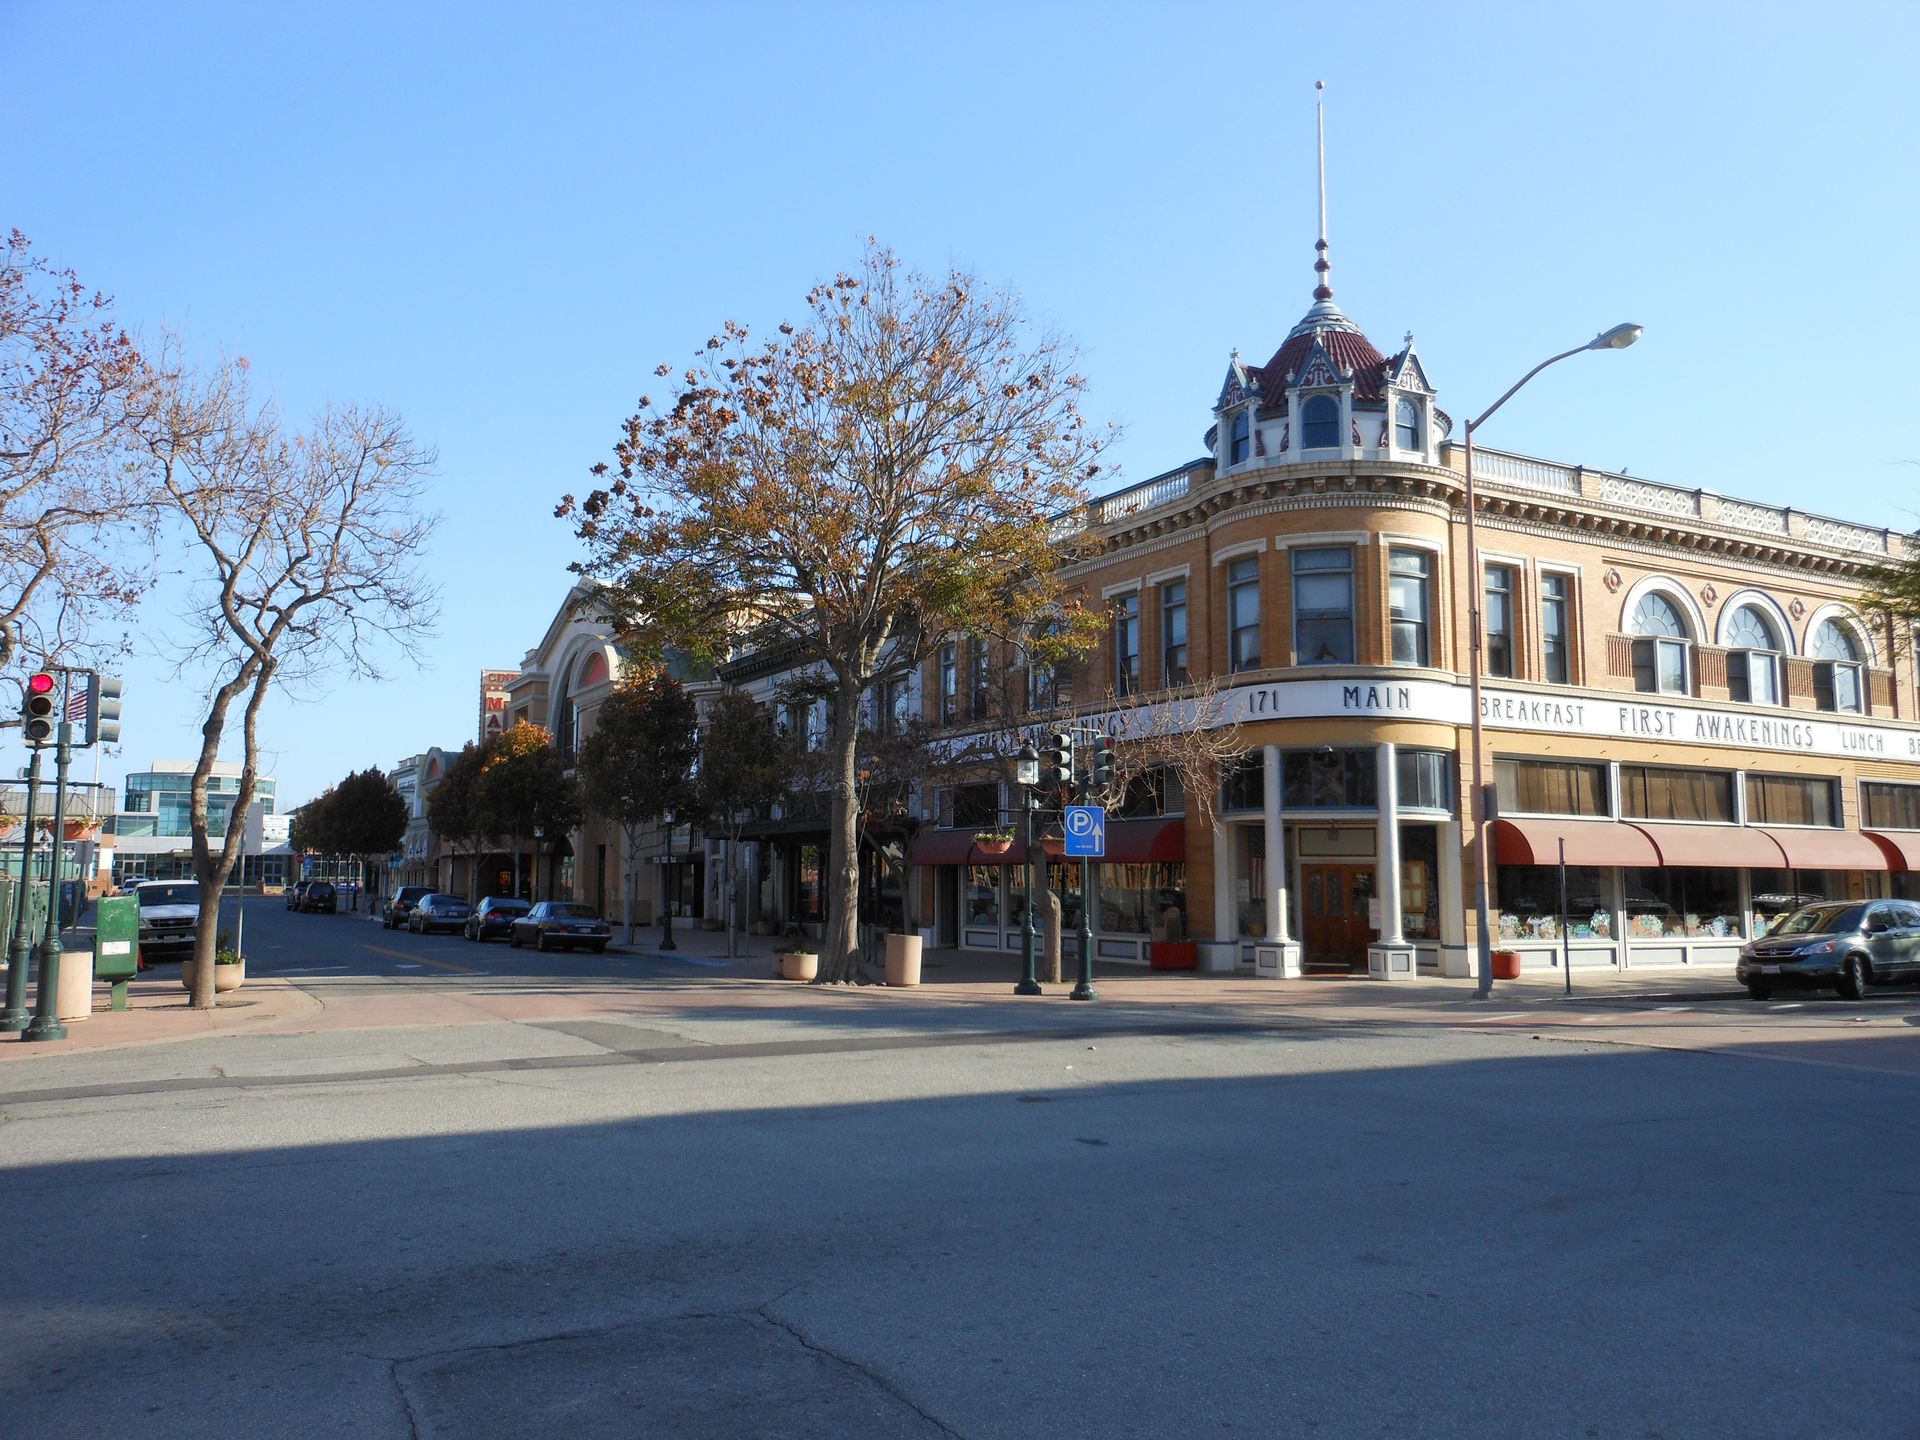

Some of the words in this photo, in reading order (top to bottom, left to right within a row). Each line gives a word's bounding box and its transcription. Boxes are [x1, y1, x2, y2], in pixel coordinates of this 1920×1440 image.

[489, 673, 521, 682] CINE
[1249, 690, 1278, 713] 171
[1343, 686, 1410, 709] MAIN
[1480, 697, 1585, 726] BREAKFAST
[1619, 707, 1675, 735] FIRST
[1695, 714, 1814, 747] AWAKENINGS
[1841, 730, 1884, 753] LUNCH
